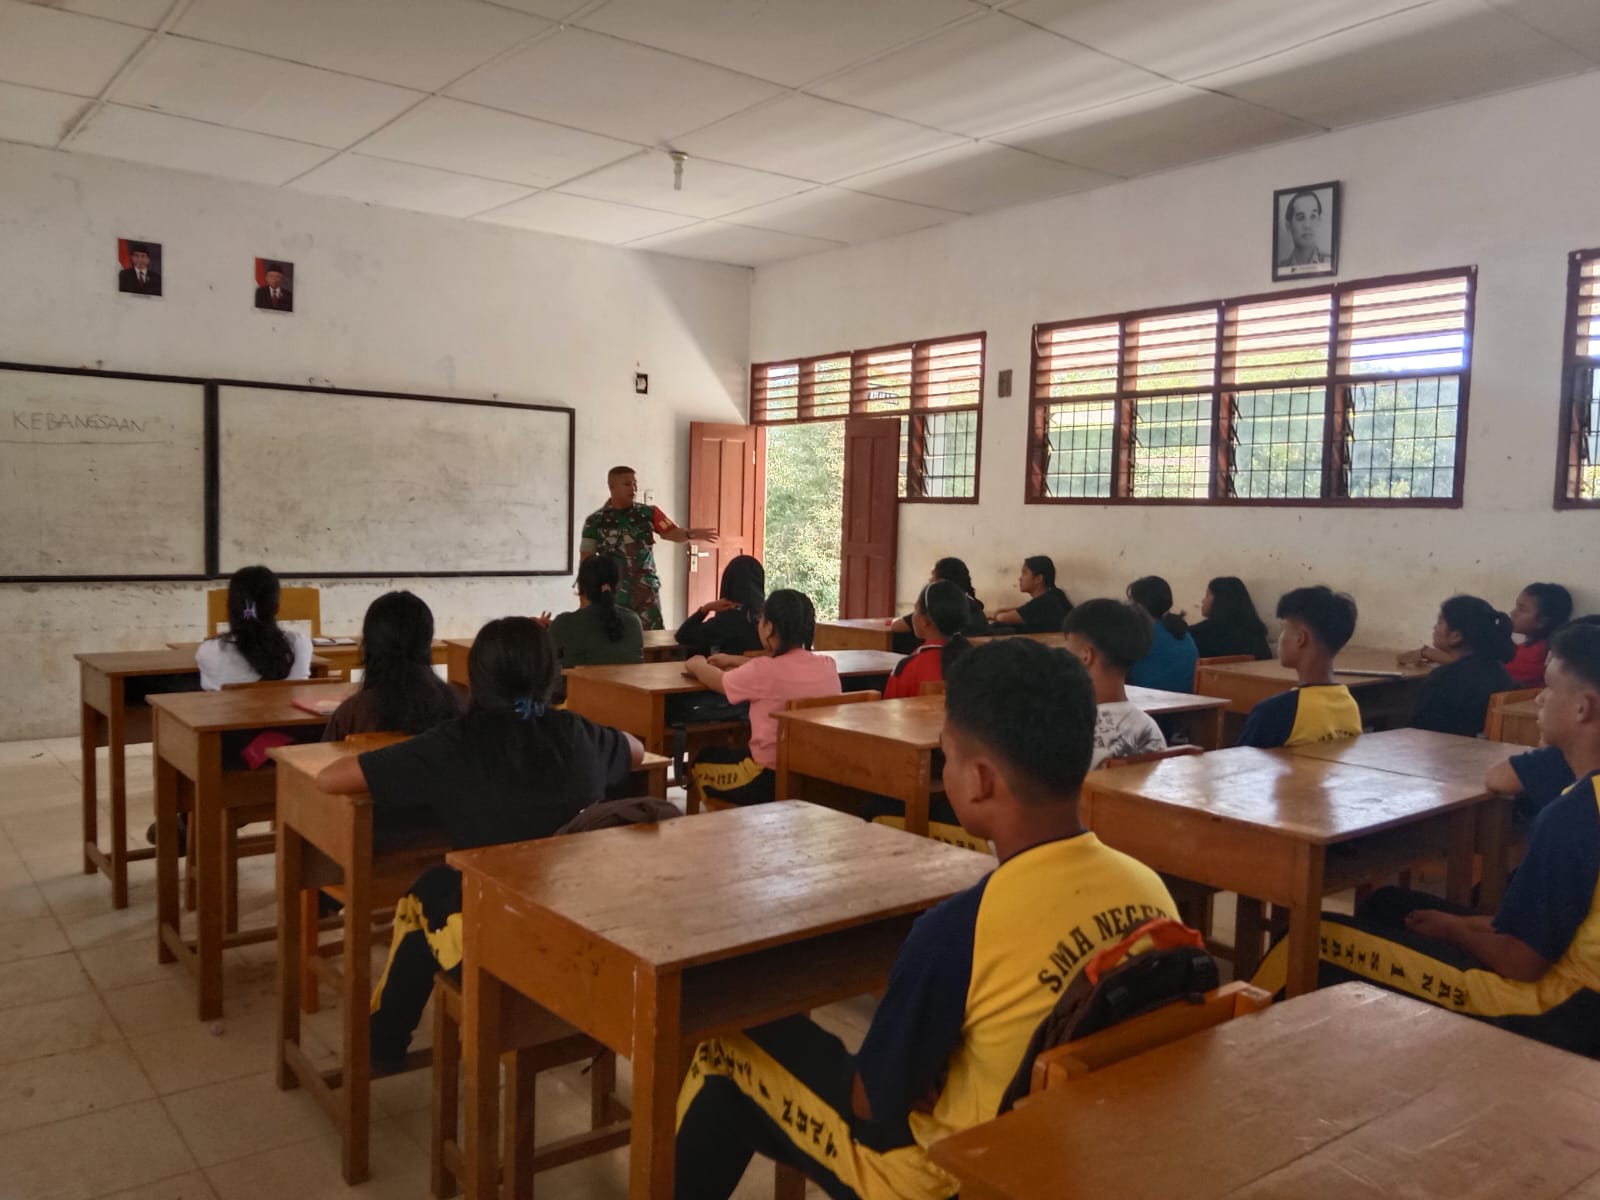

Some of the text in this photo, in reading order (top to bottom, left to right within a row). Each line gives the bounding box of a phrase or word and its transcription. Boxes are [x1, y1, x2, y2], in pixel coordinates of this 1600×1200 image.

[12, 409, 145, 433] KEBANGSAAN
[1038, 904, 1168, 994] SMA NEG
